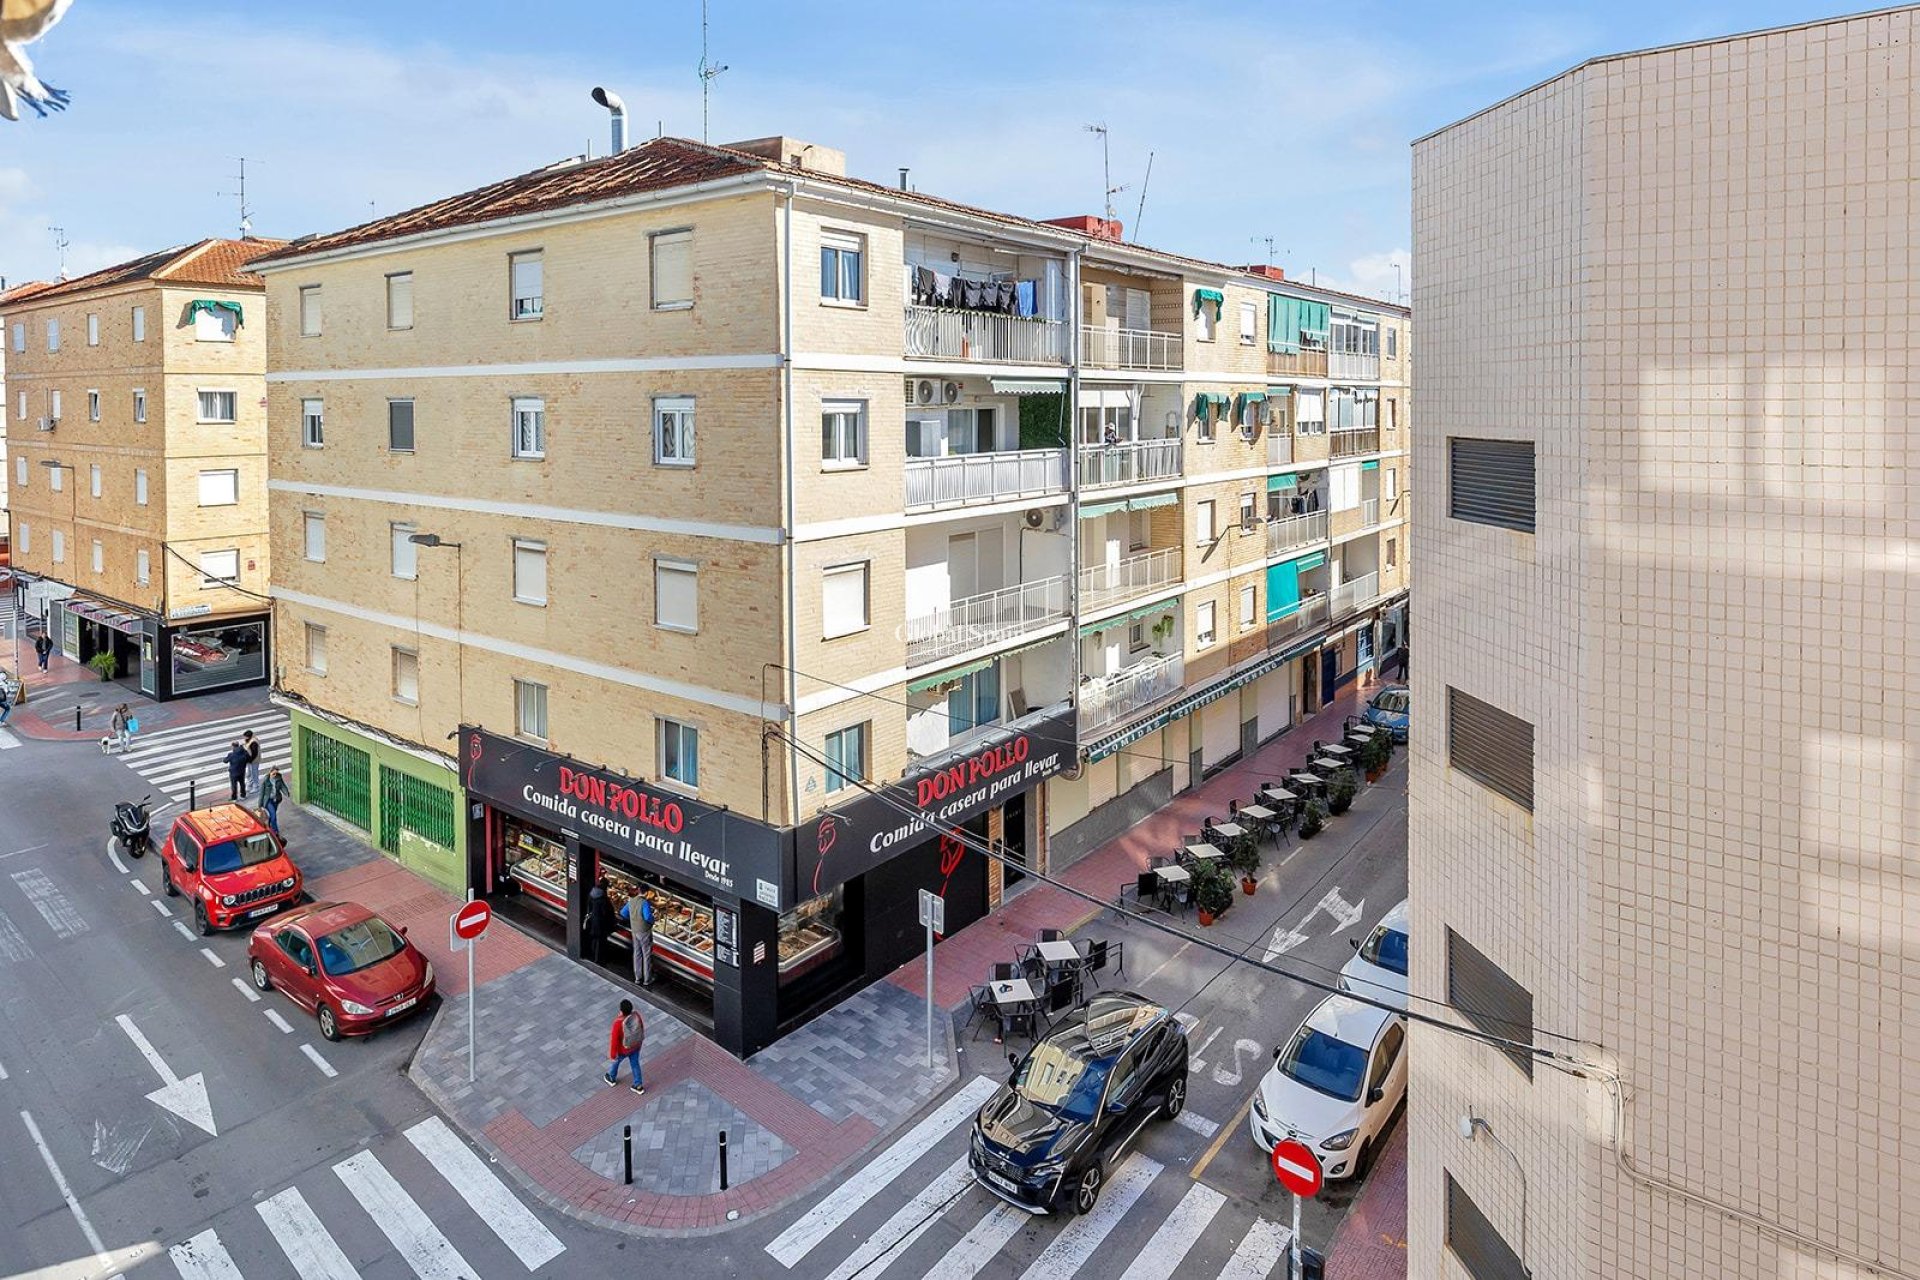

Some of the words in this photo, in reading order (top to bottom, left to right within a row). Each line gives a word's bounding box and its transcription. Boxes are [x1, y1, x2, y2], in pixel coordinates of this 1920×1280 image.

[917, 762, 965, 807] DON
[968, 736, 1029, 784] POLLO
[1102, 719, 1161, 757] COMIDAS
[522, 785, 578, 819] Comida
[581, 810, 631, 840] casera
[634, 830, 675, 856] para
[679, 841, 731, 876] llevar
[559, 766, 606, 807] DON
[608, 782, 684, 834] POLLO
[869, 811, 937, 853] Comida
[939, 788, 987, 820] casera
[989, 774, 1021, 800] para
[1024, 752, 1059, 779] llevar
